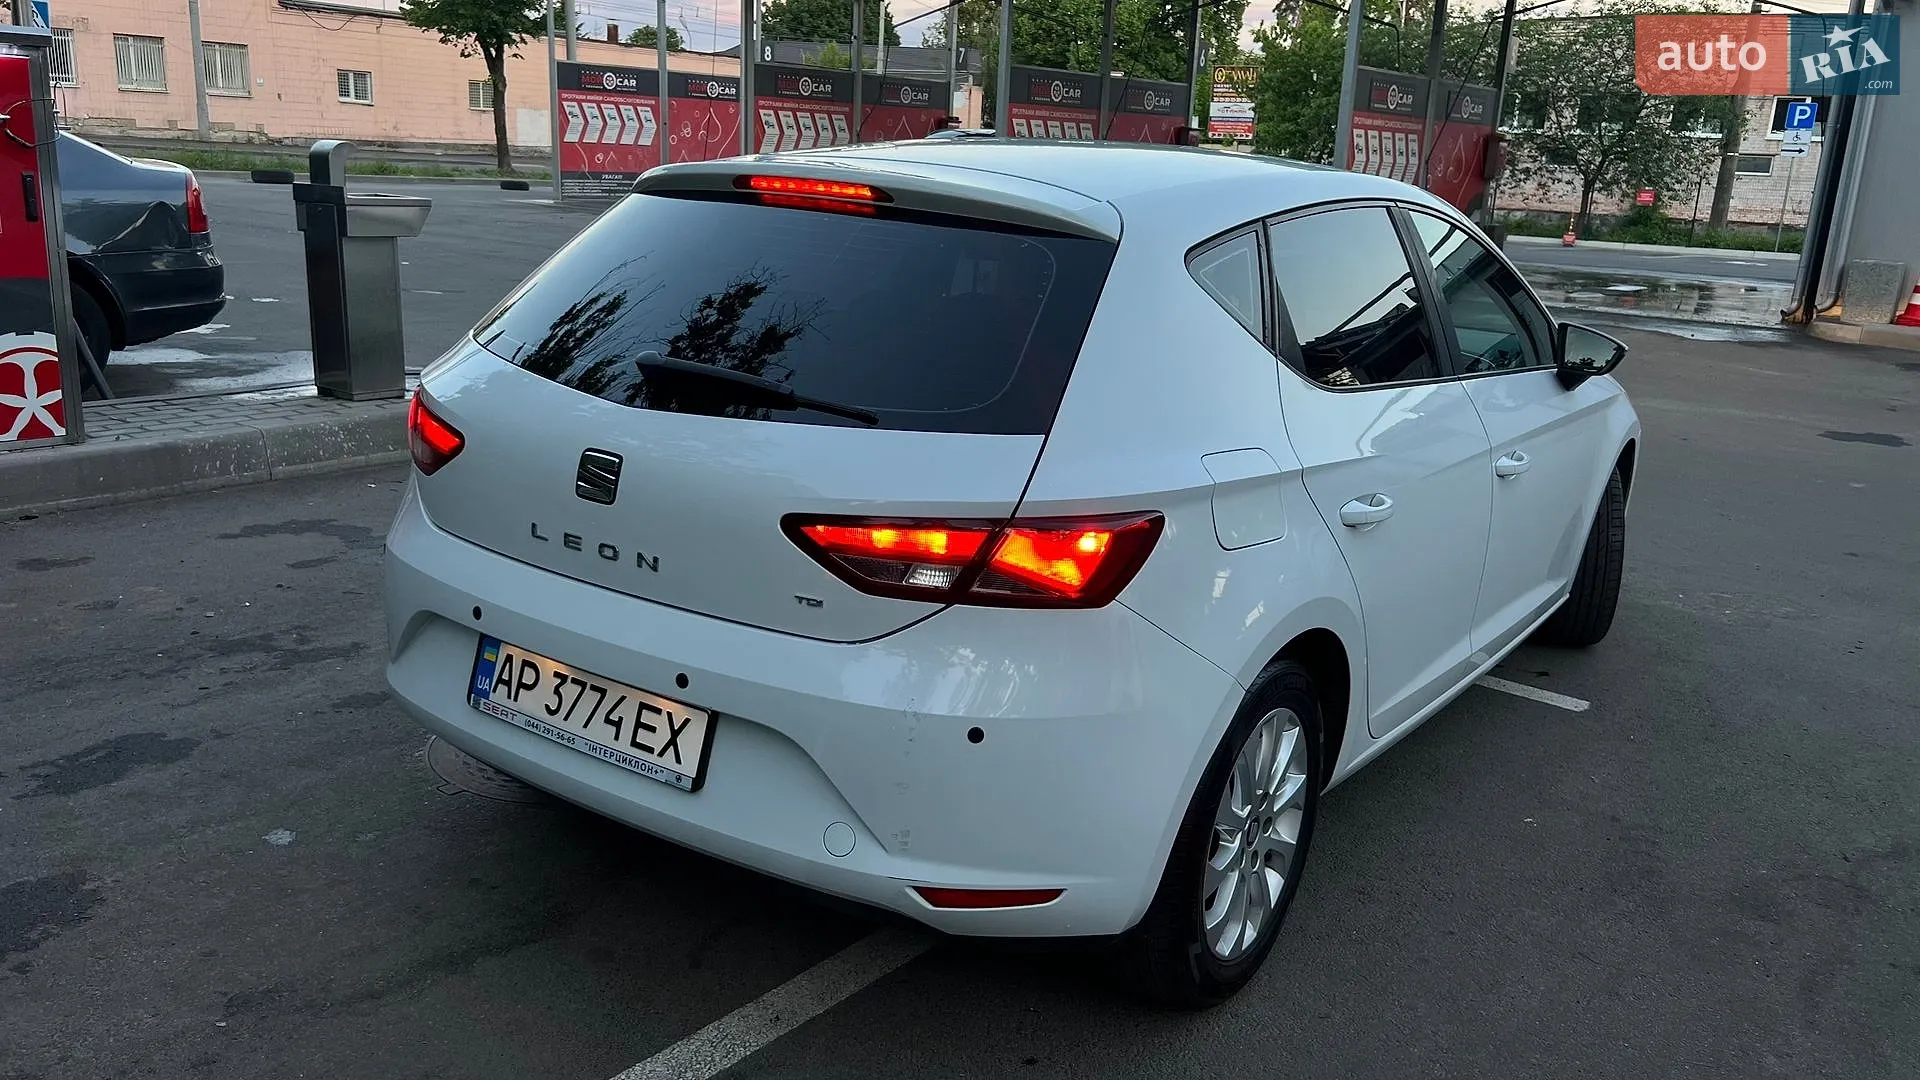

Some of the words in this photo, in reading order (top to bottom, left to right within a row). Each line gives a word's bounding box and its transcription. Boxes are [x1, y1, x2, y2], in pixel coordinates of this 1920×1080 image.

[764, 46, 772, 61] 8
[959, 47, 966, 64] 7
[1199, 48, 1206, 67] 6
[1793, 105, 1811, 127] P
[530, 521, 660, 573] LEON
[794, 595, 824, 609] TDI
[476, 675, 490, 693] UA
[492, 653, 541, 703] AP
[544, 670, 627, 741] 3774
[630, 700, 692, 765] EX
[482, 701, 518, 721] SEAT
[524, 718, 541, 733] (044)
[542, 725, 576, 745] 291-56-65
